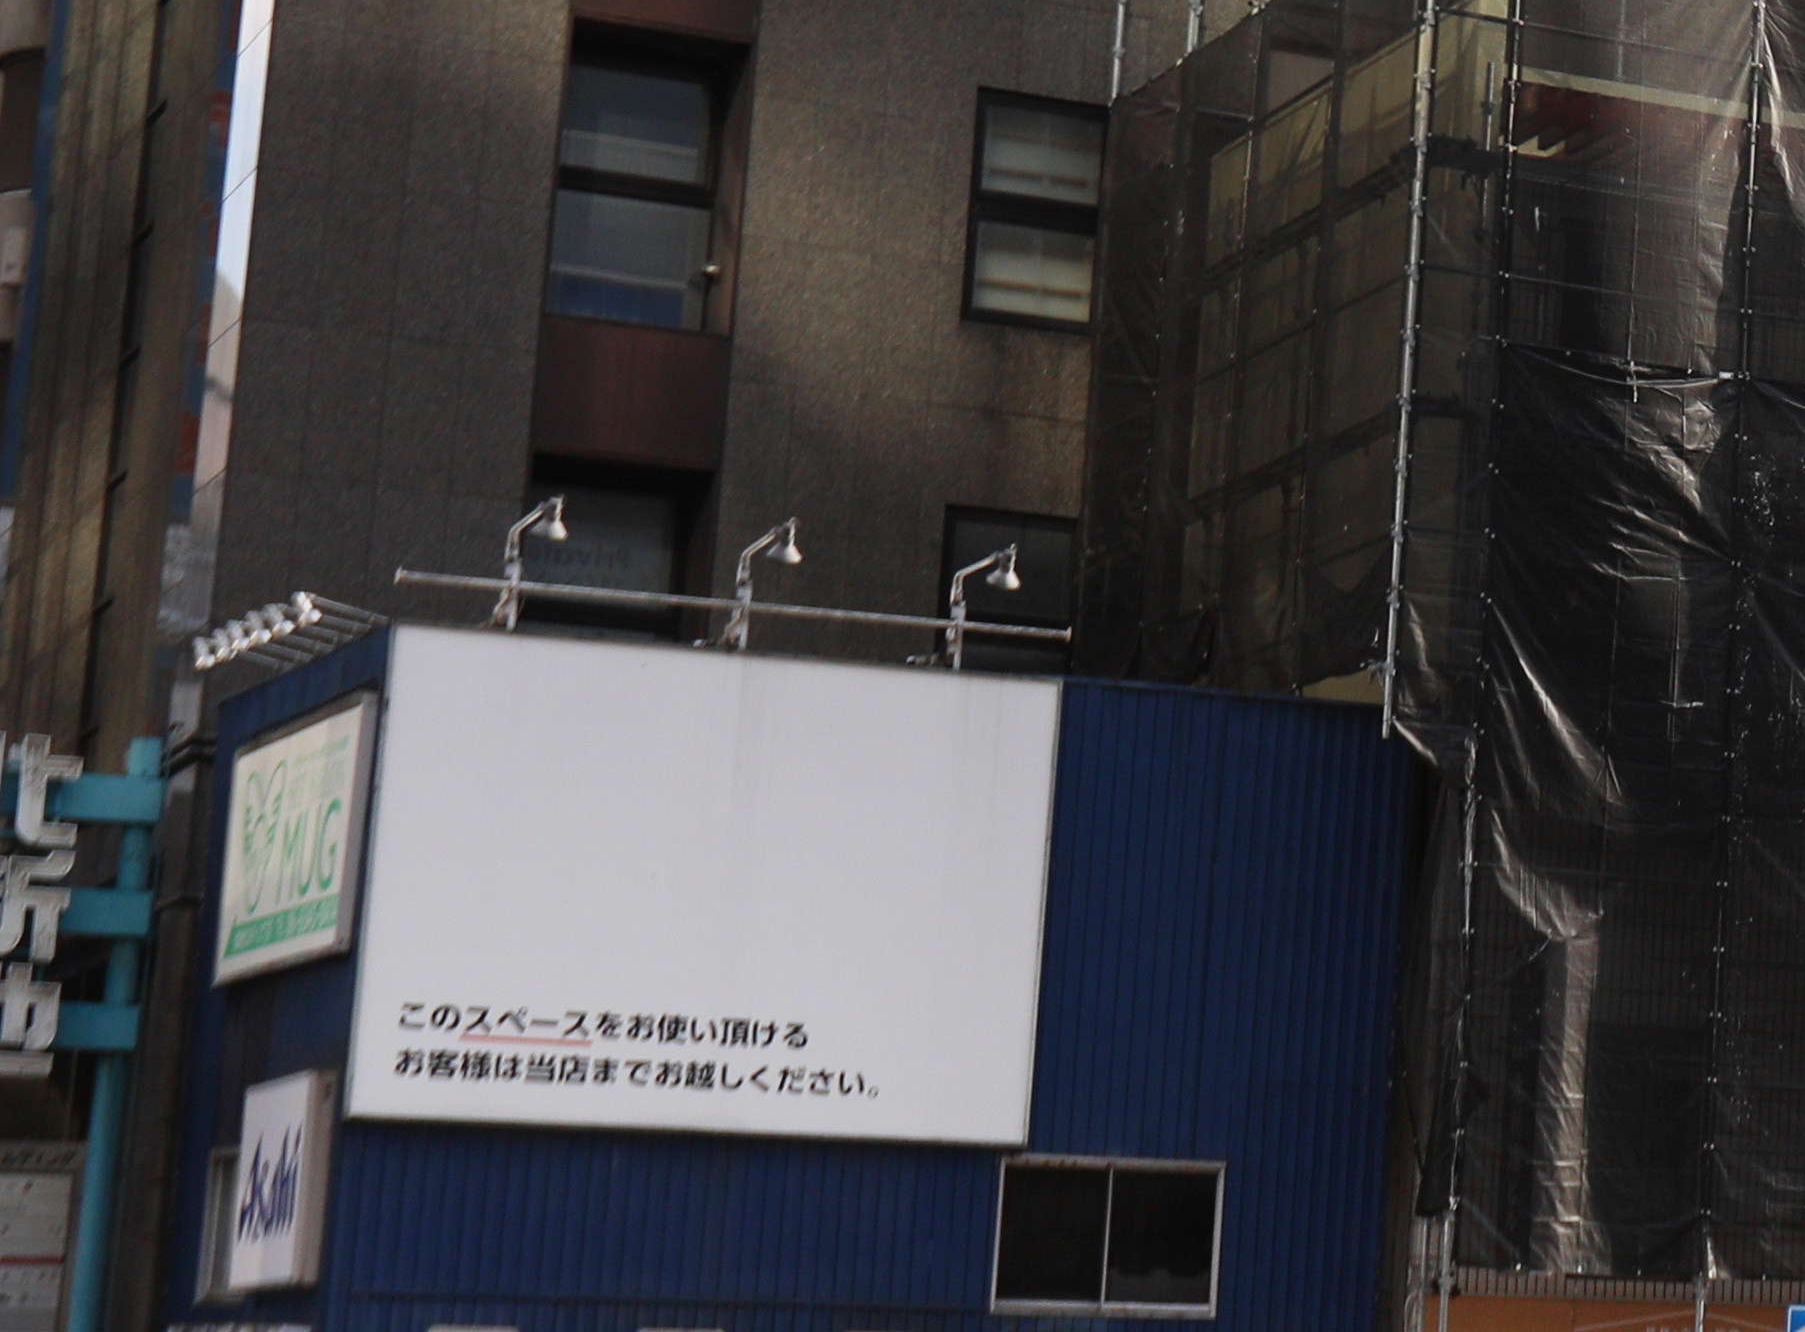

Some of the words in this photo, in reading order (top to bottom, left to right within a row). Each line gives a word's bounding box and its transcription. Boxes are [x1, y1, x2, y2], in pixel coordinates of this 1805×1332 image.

[398, 1001, 809, 1049] このスペースをお使い頂ける
[394, 1047, 880, 1099] お客様は当店までお越しください。
